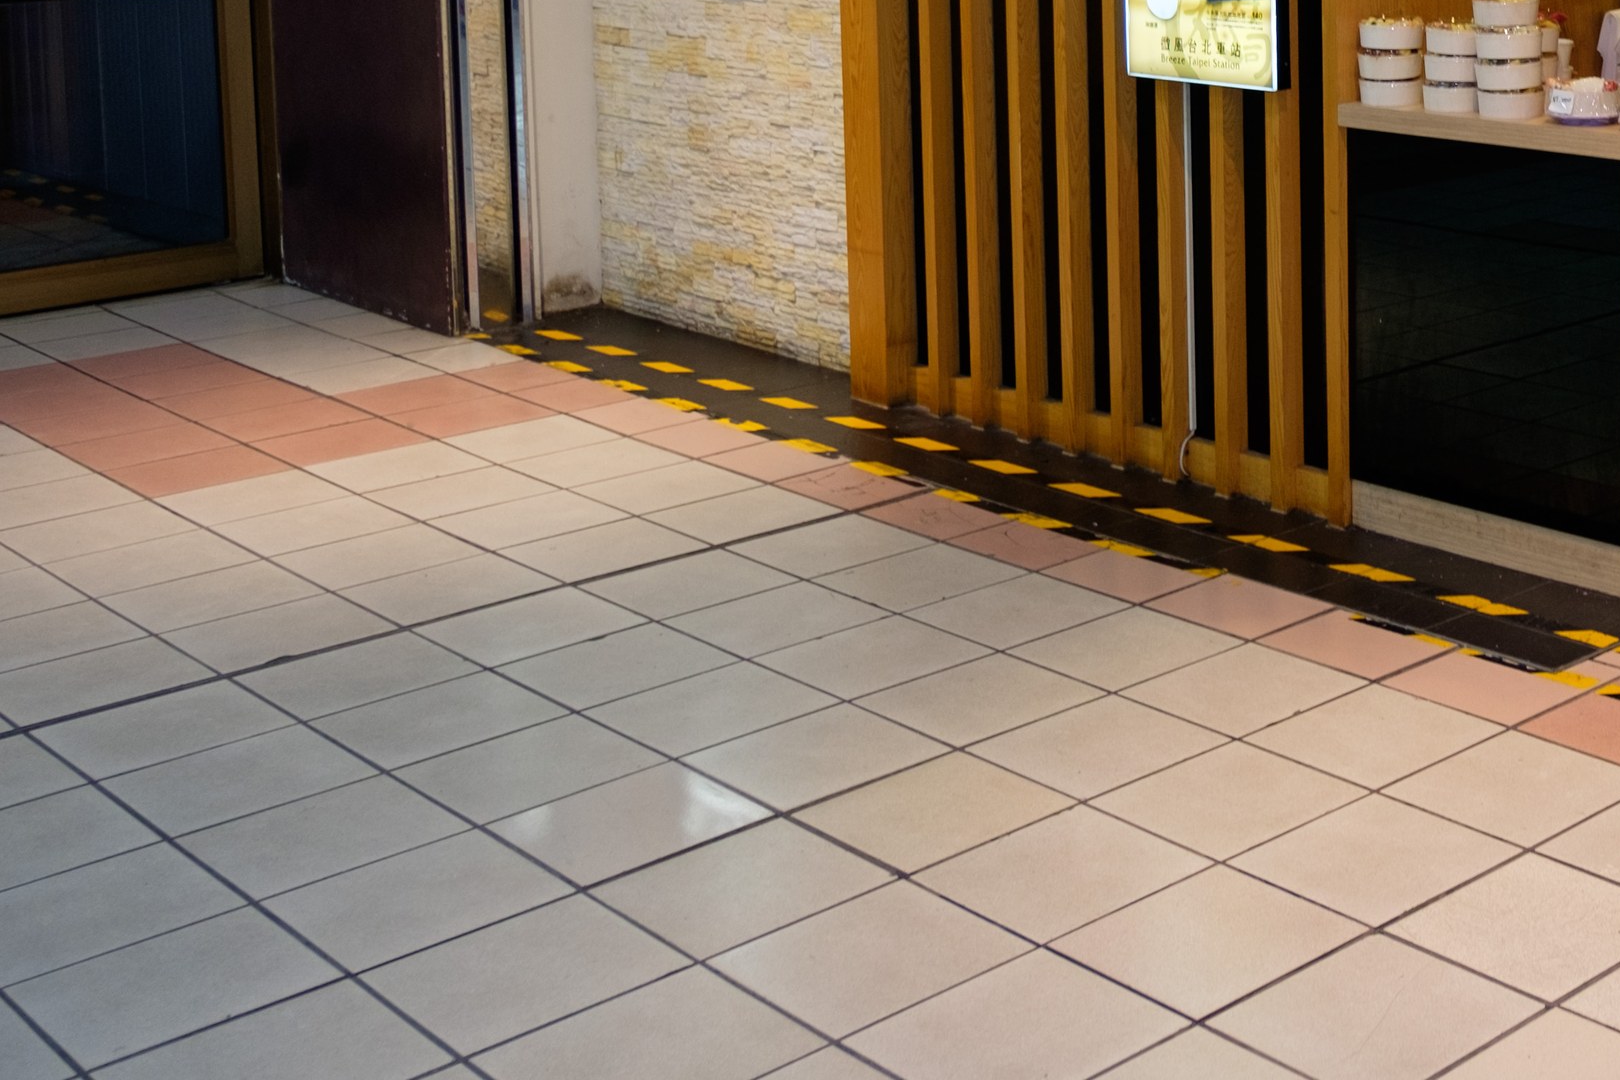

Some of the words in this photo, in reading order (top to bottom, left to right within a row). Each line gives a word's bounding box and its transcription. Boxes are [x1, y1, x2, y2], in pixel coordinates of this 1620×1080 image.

[1160, 52, 1186, 66] Breeze
[1188, 57, 1212, 70] Taipei
[1213, 58, 1241, 71] Station
